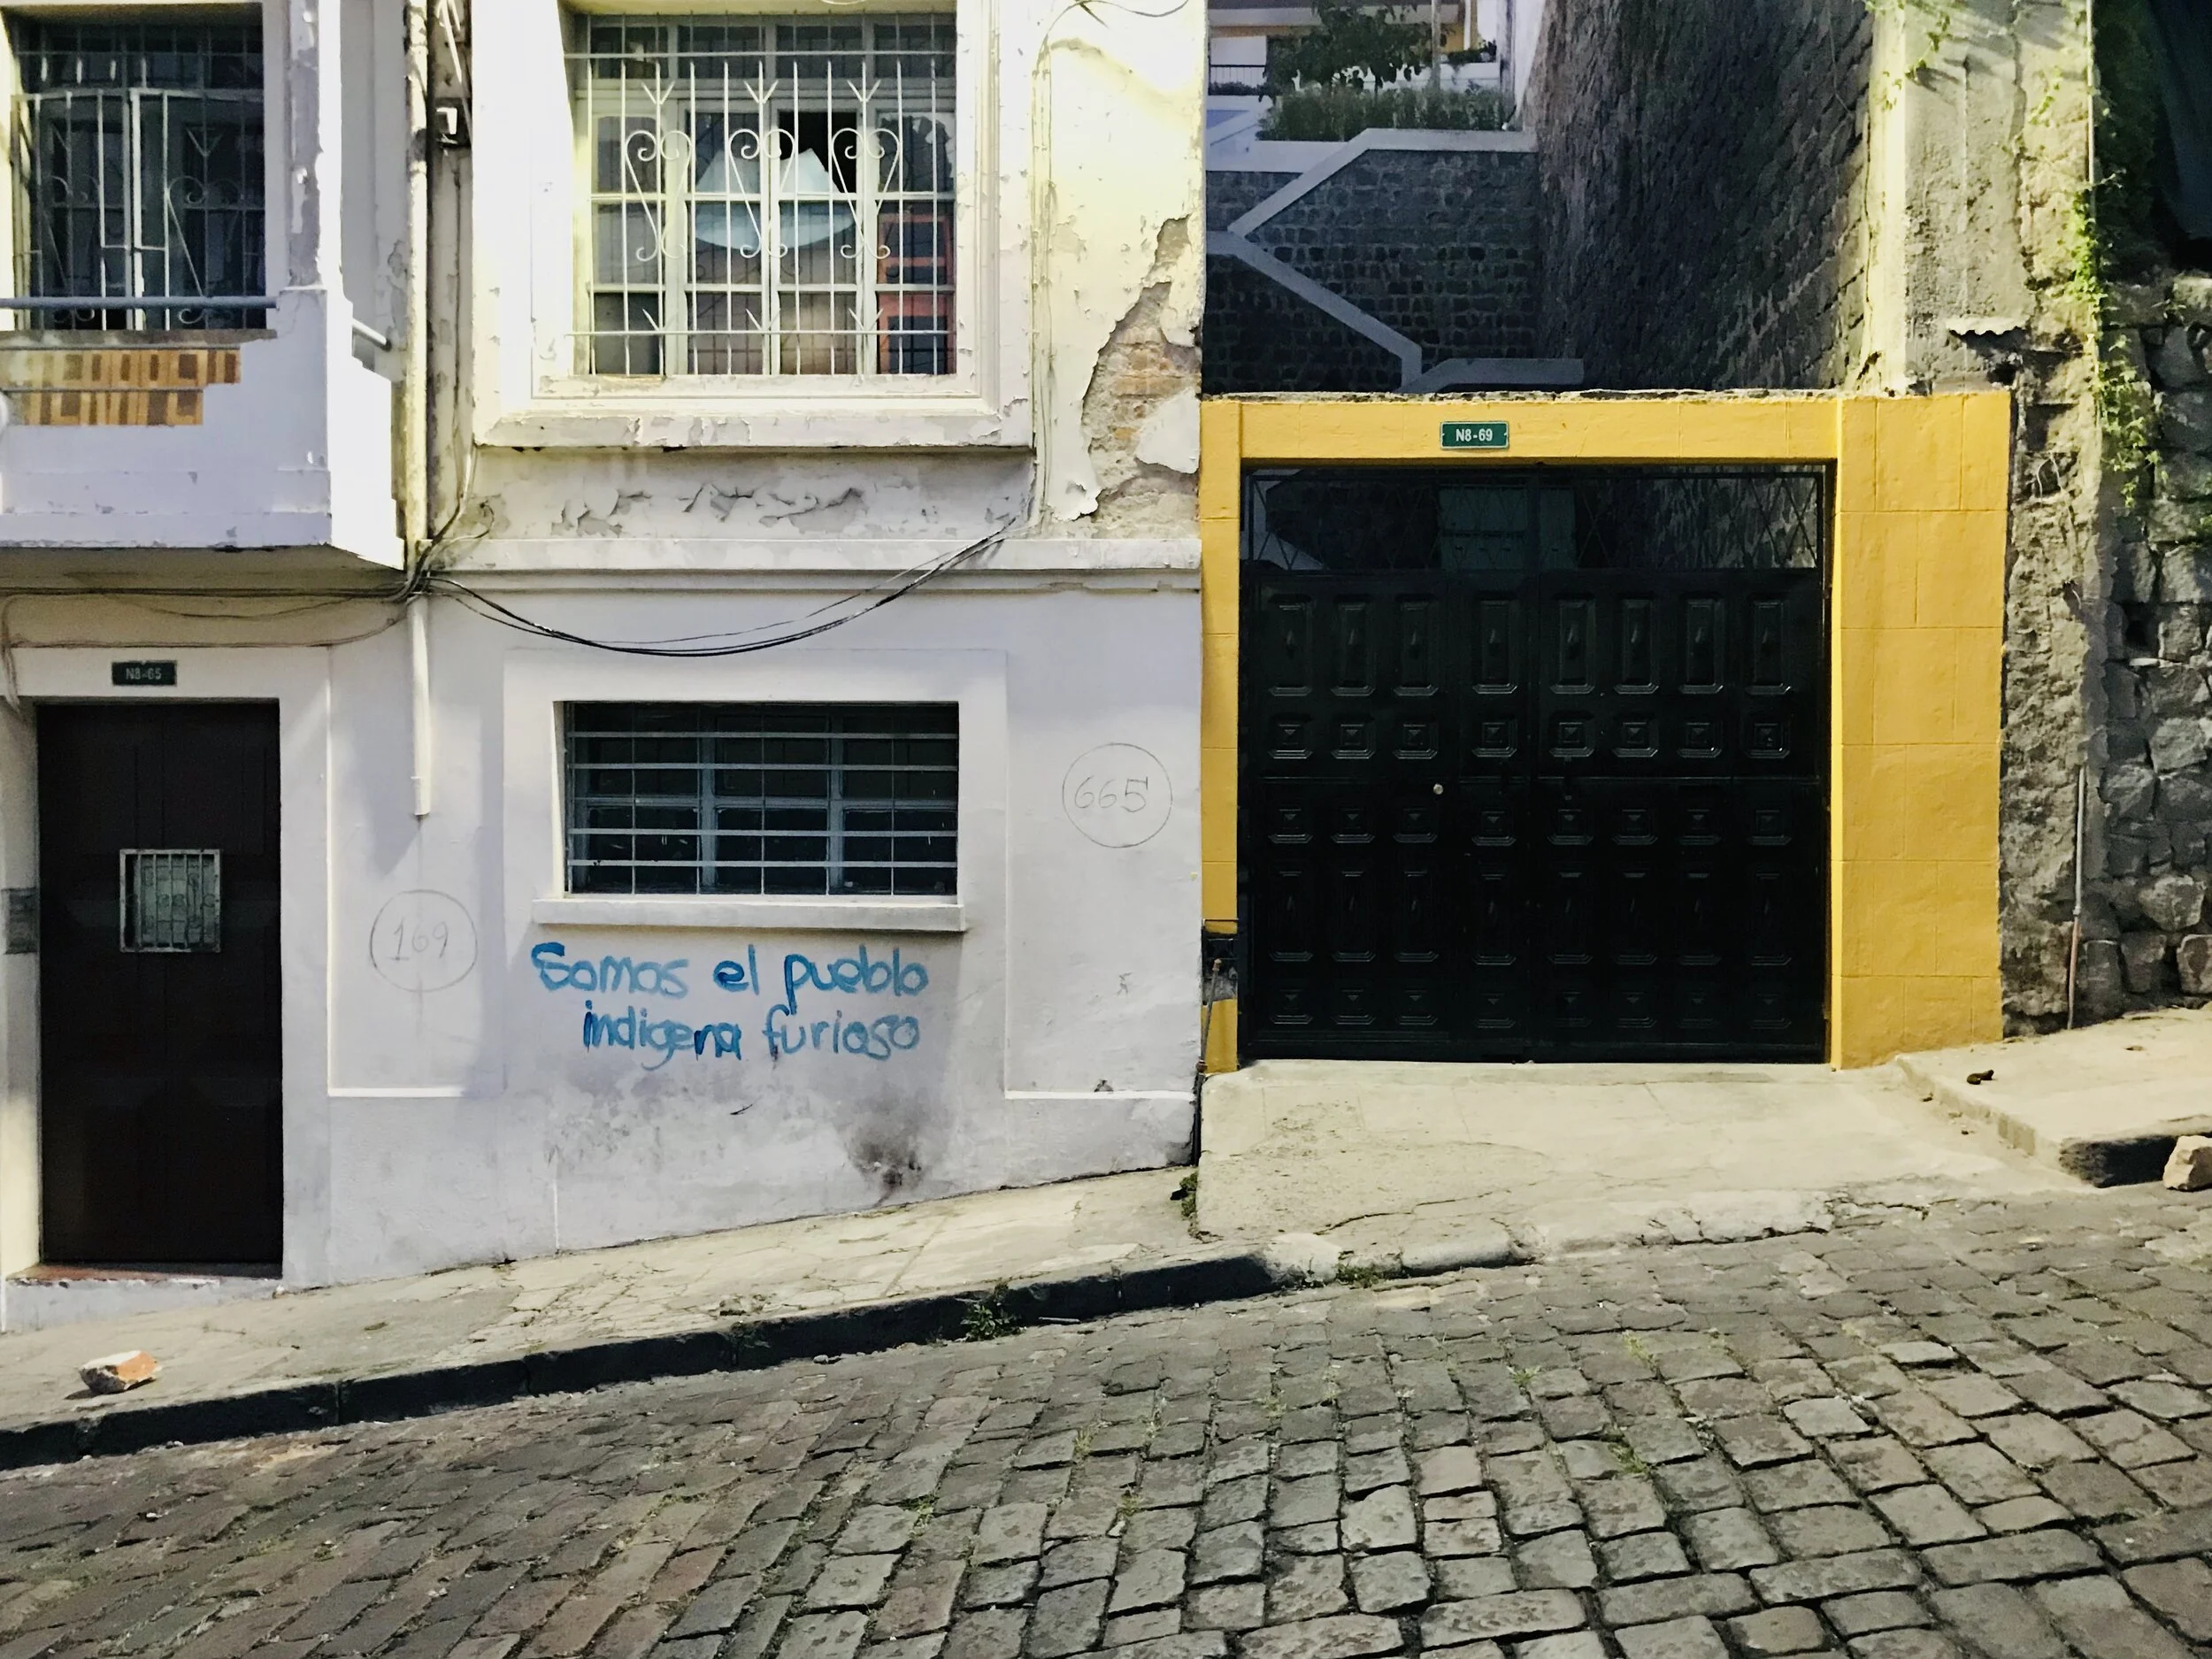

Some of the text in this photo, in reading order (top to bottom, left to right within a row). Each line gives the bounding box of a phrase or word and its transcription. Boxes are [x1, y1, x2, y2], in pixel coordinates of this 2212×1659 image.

[1455, 428, 1494, 442] N8-69
[126, 667, 162, 680] N8-65
[1074, 775, 1148, 813] 665
[391, 918, 449, 962] 169
[531, 941, 929, 1015] Somos el pueblo
[583, 999, 920, 1071] indigena furioso
